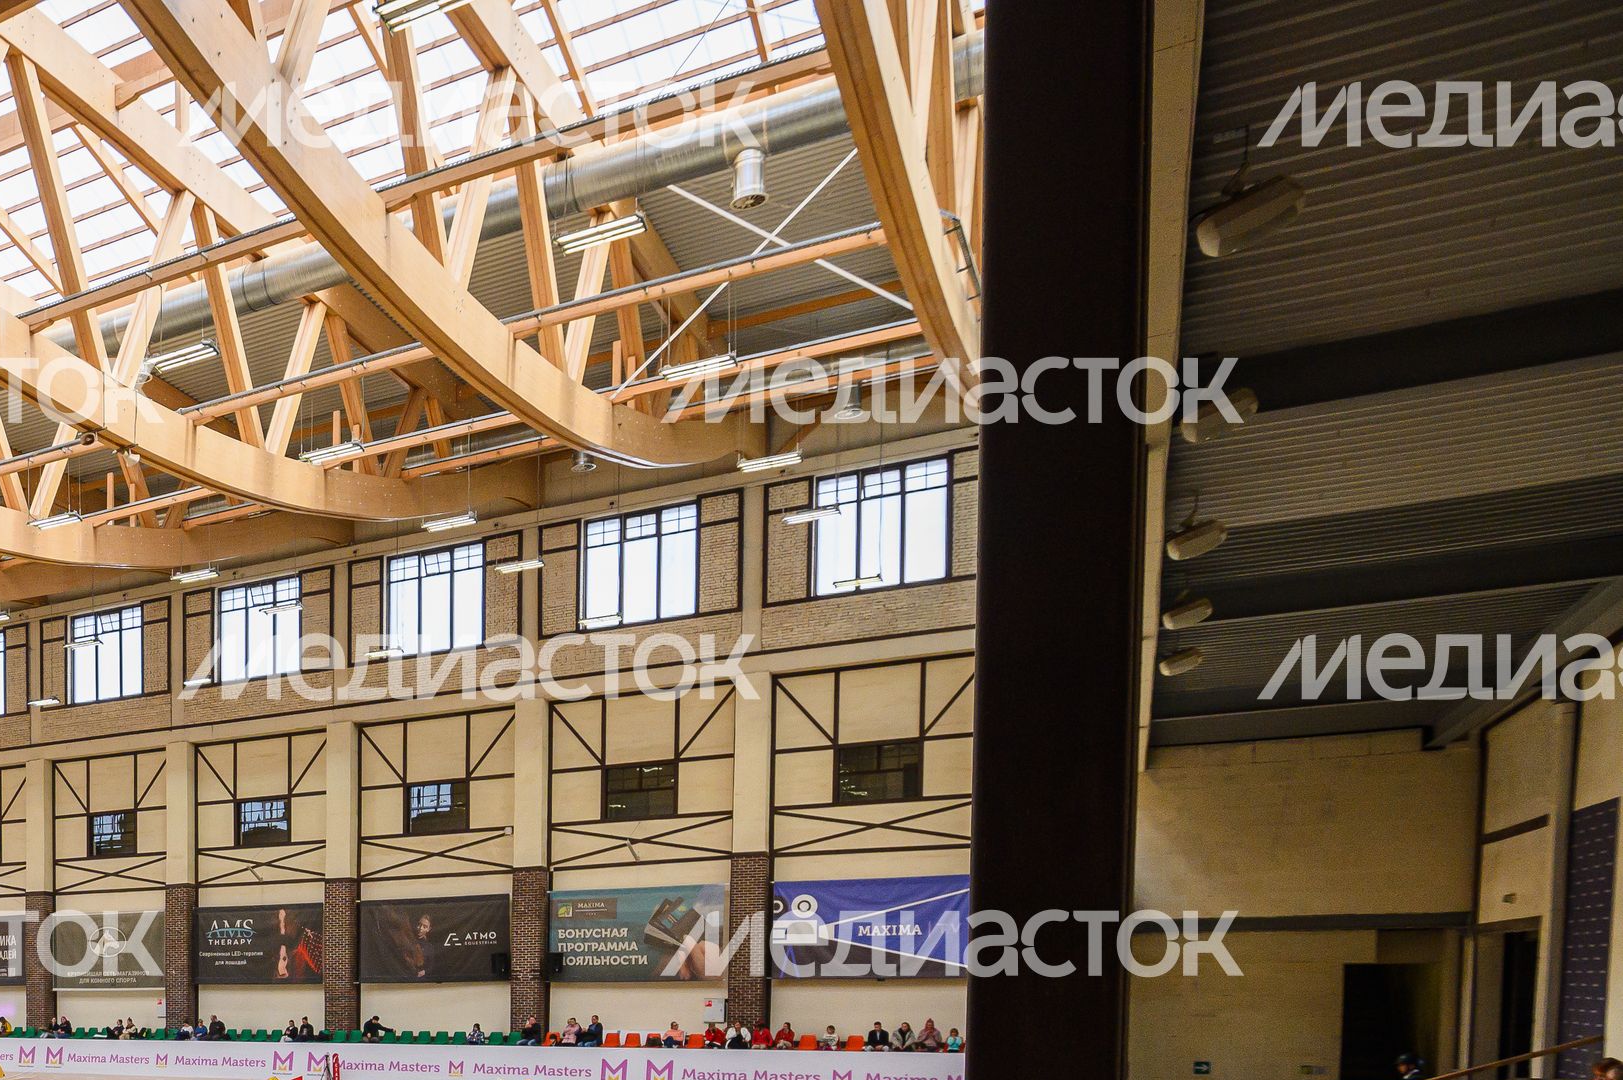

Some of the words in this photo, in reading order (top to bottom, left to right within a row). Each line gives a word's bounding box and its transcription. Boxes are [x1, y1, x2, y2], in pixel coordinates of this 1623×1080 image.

[207, 919, 254, 938] AMS
[558, 928, 629, 939] БОНУСНАЯ
[858, 924, 923, 937] MAXIMA
[465, 931, 497, 940] ATMO
[558, 941, 638, 952] ПРОГРАММА
[67, 1053, 106, 1063] Maxima
[109, 1053, 150, 1064] Masters
[175, 1055, 218, 1066] Maxima
[221, 1056, 266, 1067] Masters
[337, 1059, 384, 1071] Maxima
[388, 1060, 440, 1073] Masters
[473, 1063, 529, 1076] Maxima
[534, 1064, 592, 1078] Masters
